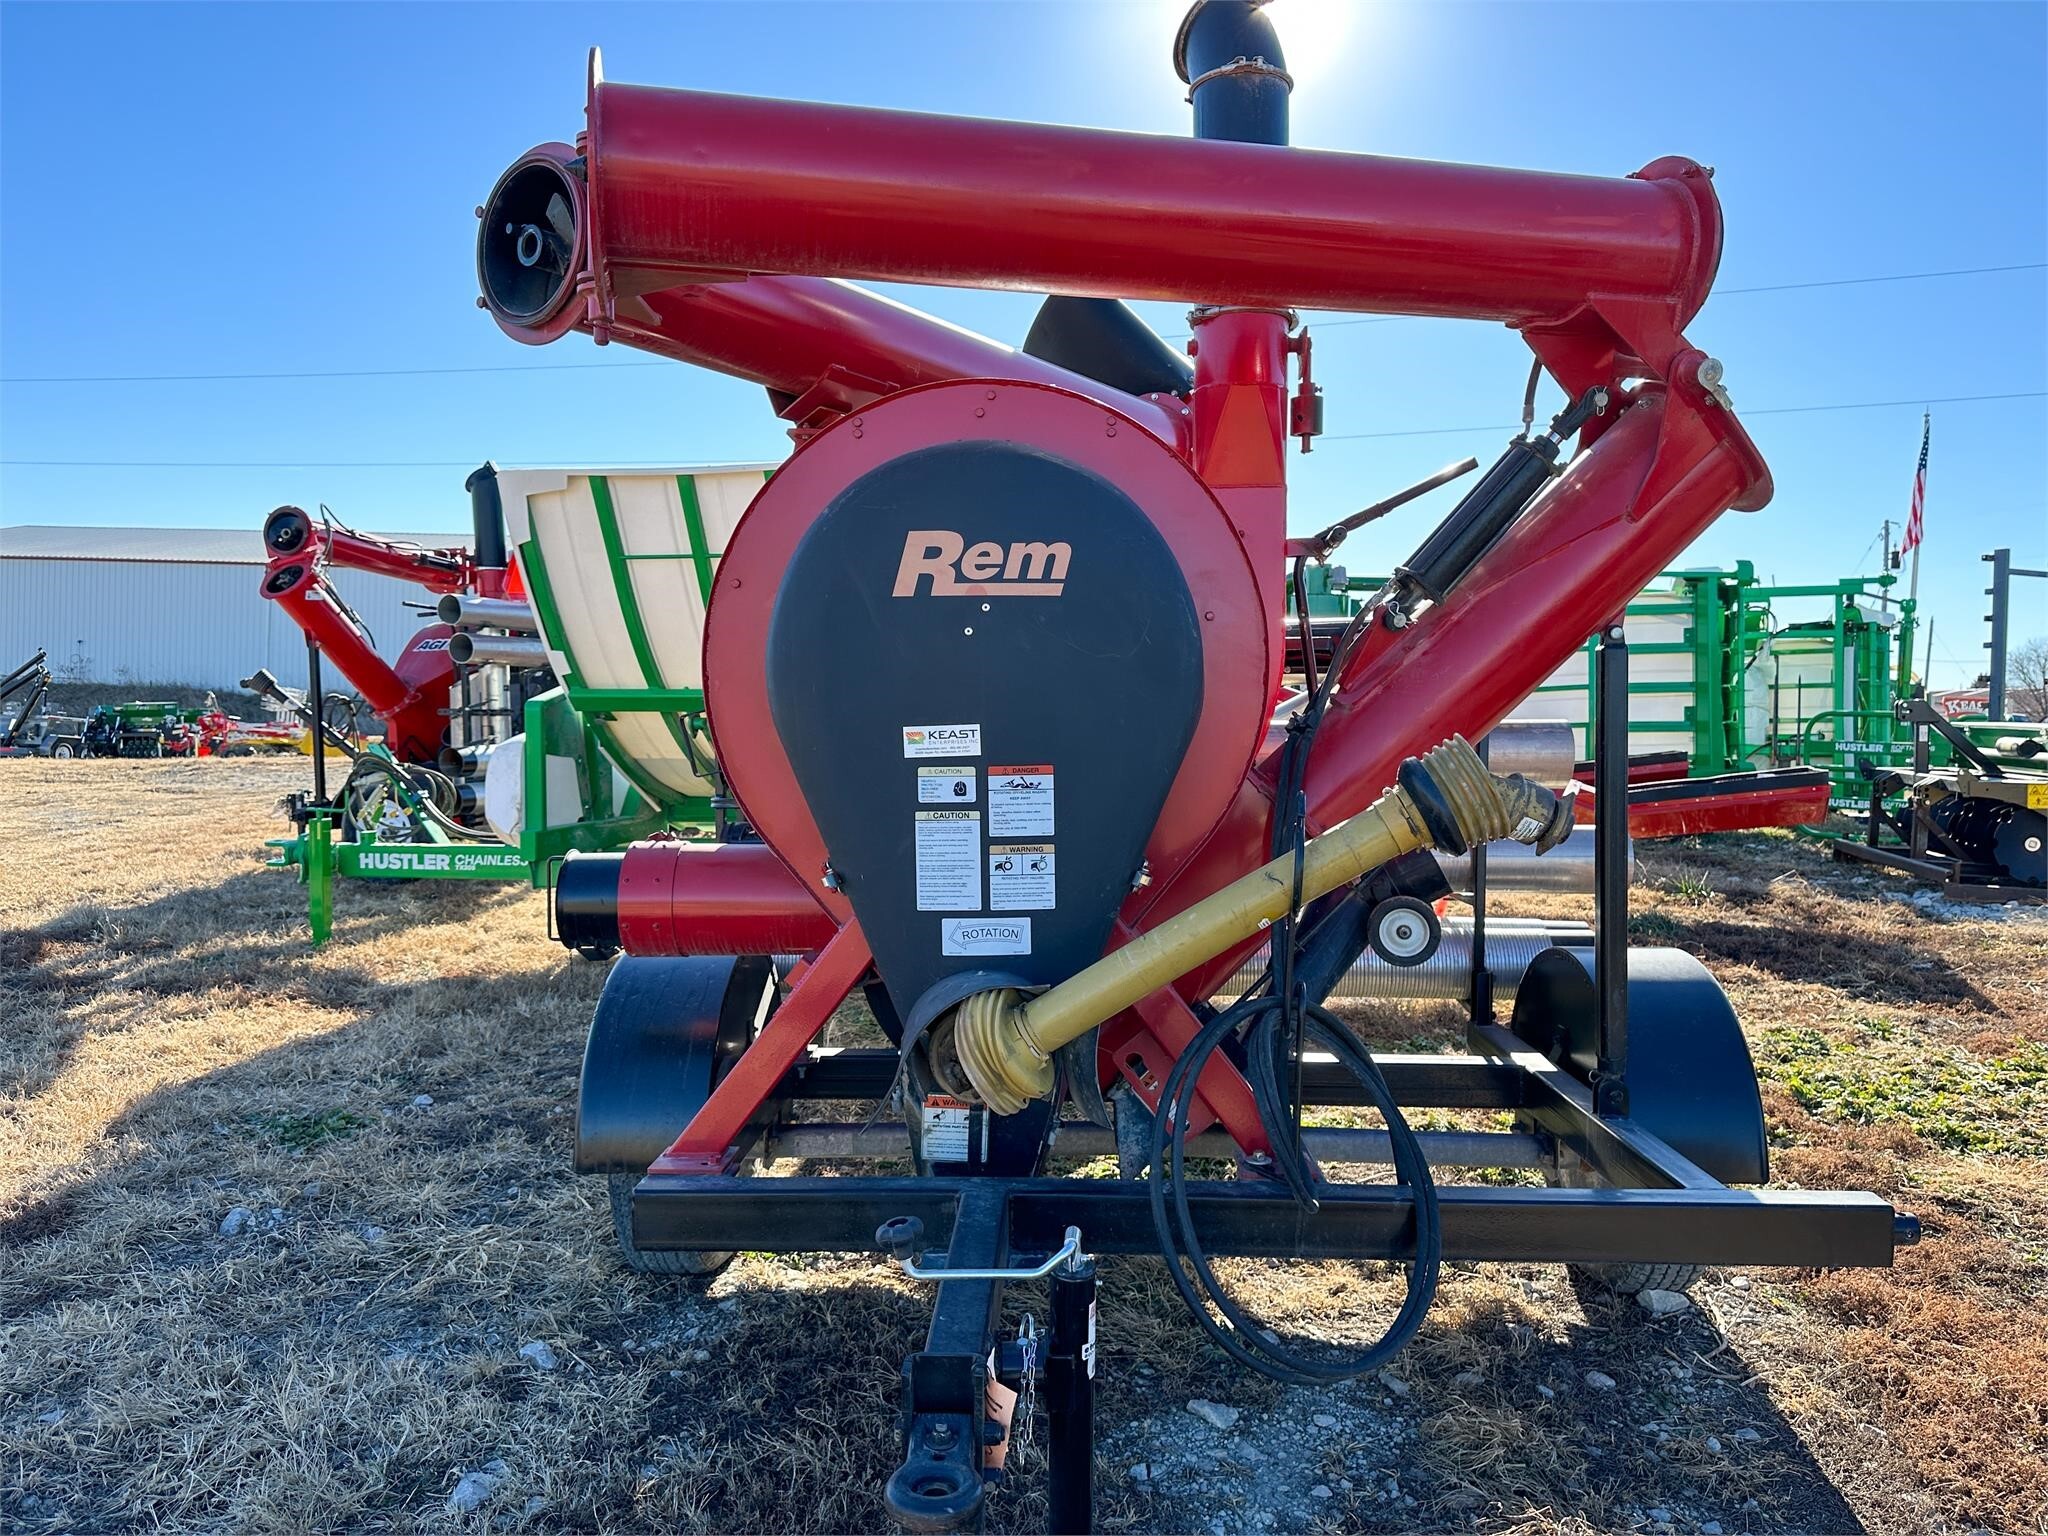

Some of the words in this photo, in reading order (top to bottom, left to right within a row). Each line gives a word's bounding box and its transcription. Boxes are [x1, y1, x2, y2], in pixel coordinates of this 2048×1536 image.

[892, 530, 1072, 597] Rem
[417, 640, 448, 650] AGI
[1945, 699, 1983, 714] KEAS
[928, 729, 978, 740] KEAST
[1835, 742, 1884, 753] HUSTLER
[359, 852, 450, 870] HUSTLER
[961, 928, 1020, 940] ROTATION
